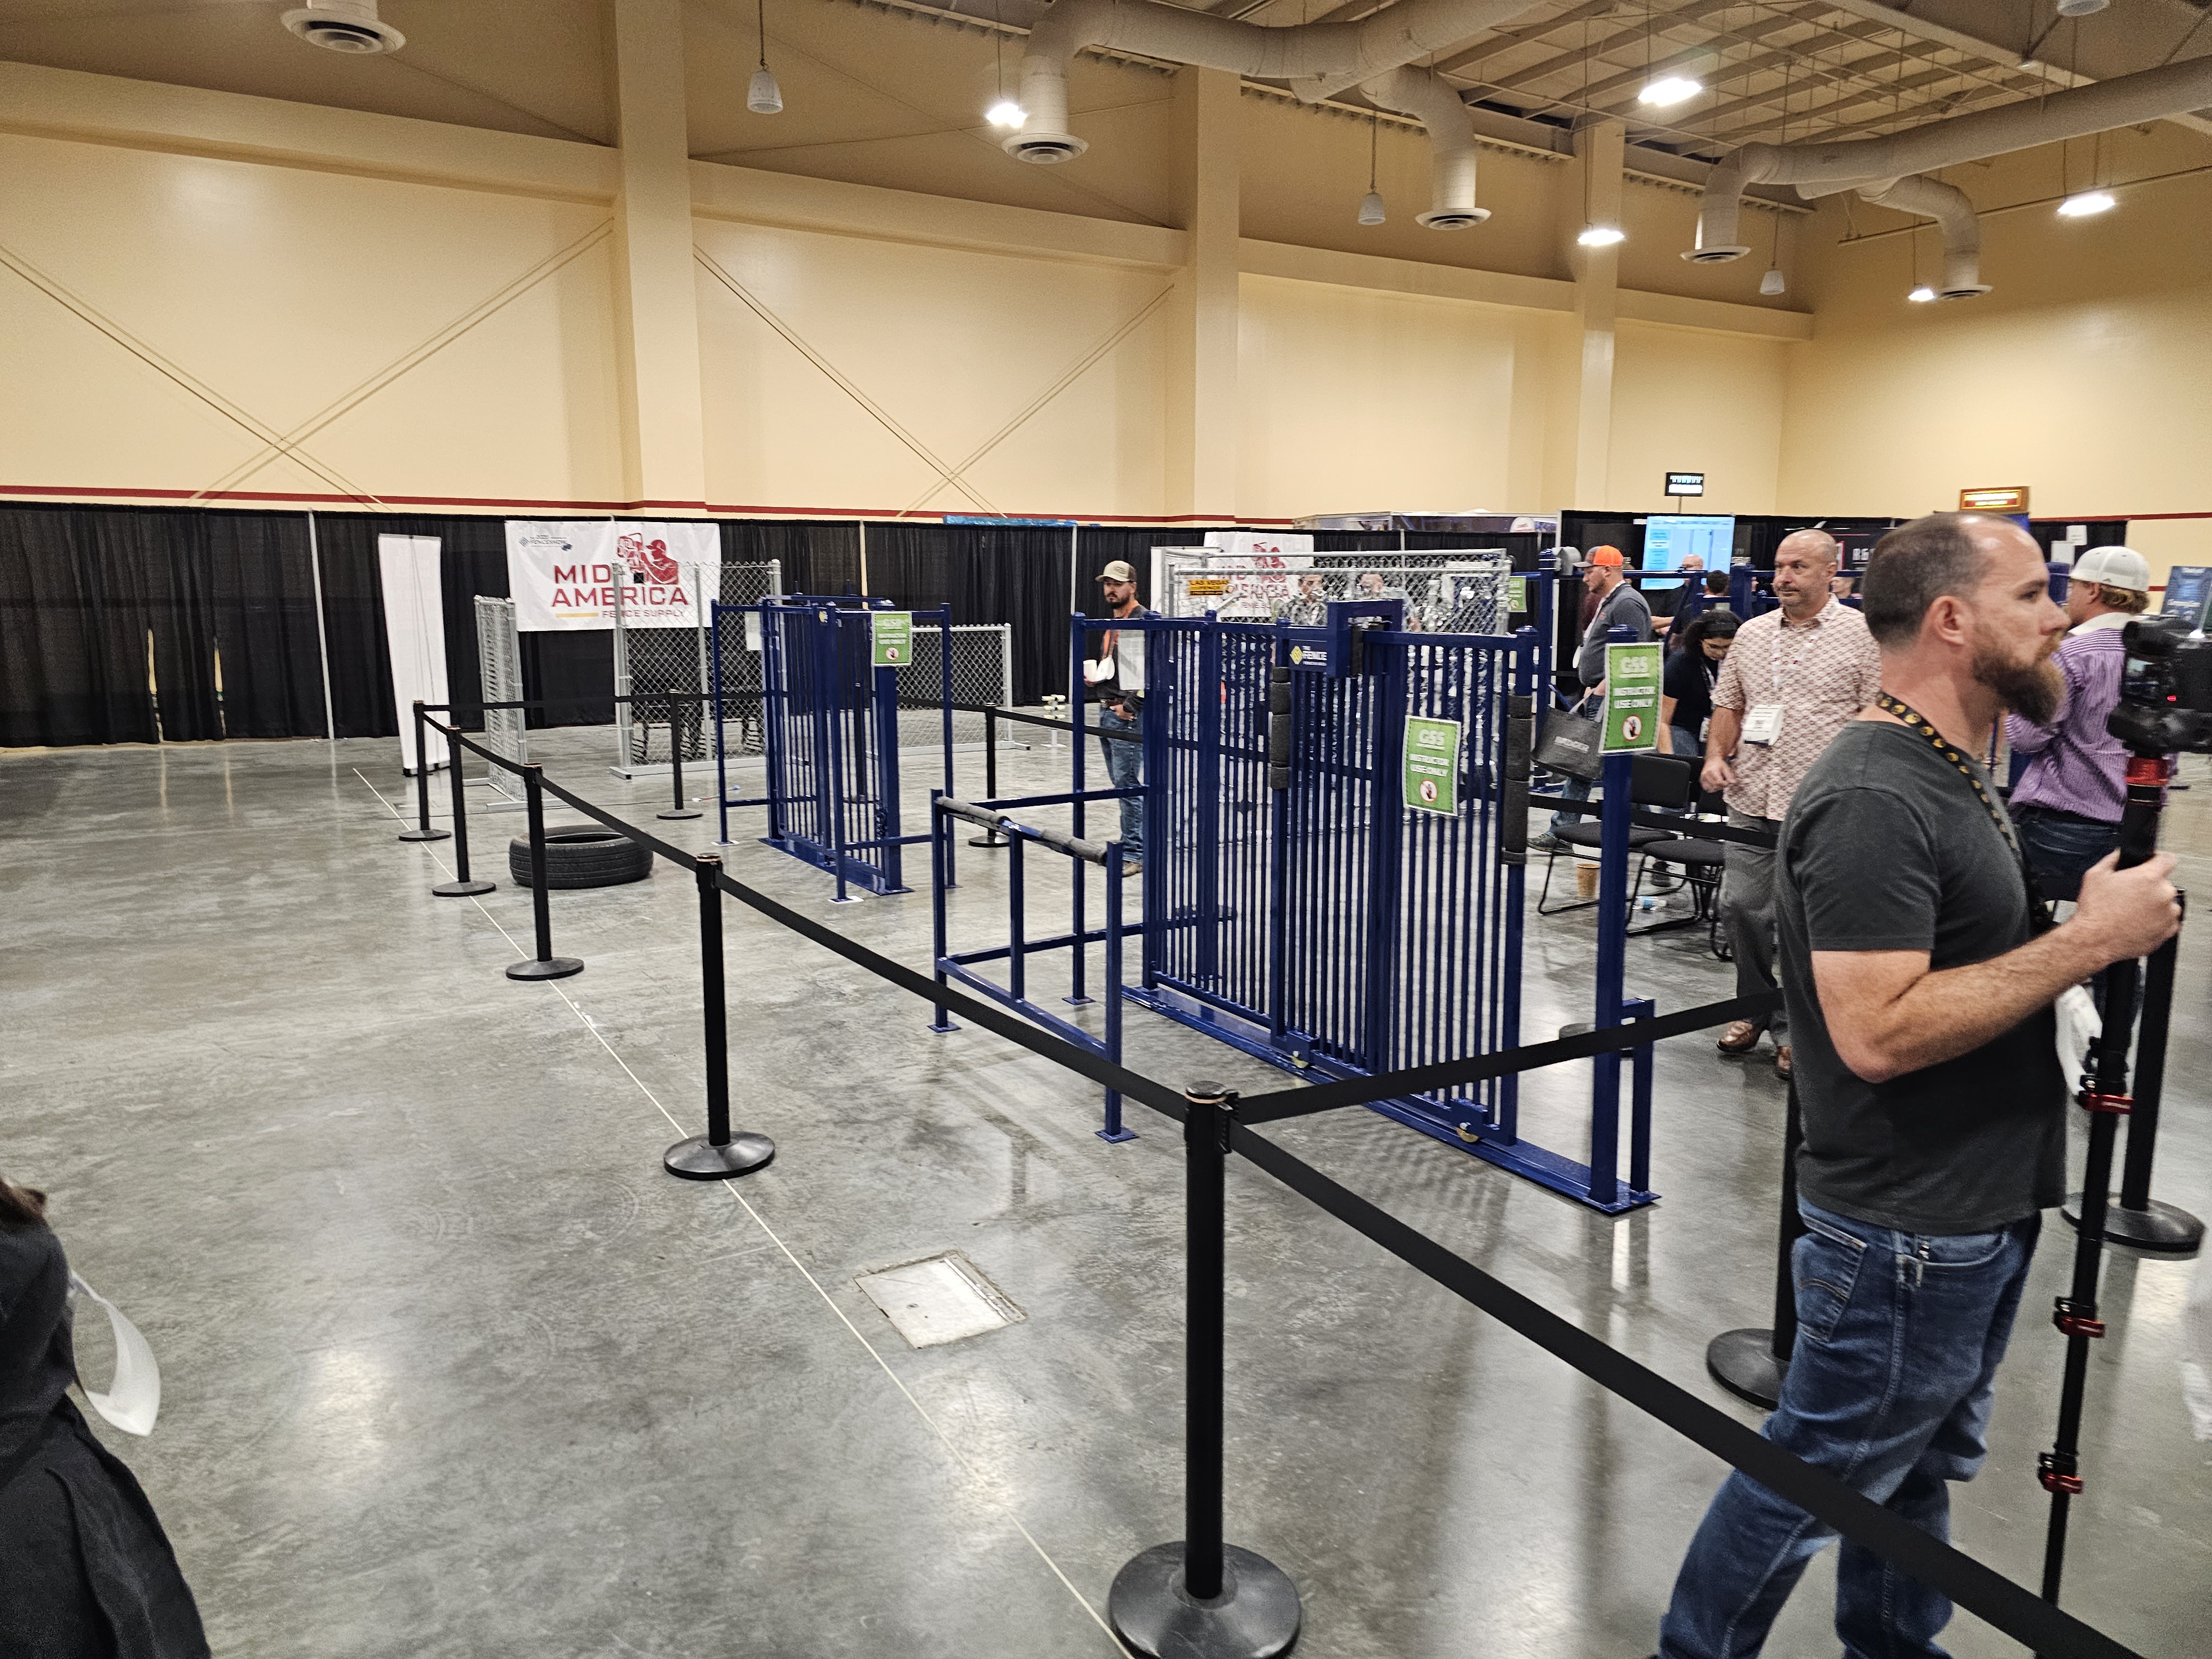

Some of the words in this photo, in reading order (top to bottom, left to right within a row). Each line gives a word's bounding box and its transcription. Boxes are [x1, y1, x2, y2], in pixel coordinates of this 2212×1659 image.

[554, 565, 611, 584] MID
[551, 587, 688, 607] AMERICA
[1614, 700, 1631, 709] USE
[1631, 698, 1653, 708] ONLY
[1410, 764, 1426, 773] USE
[1426, 767, 1448, 777] ONLY
